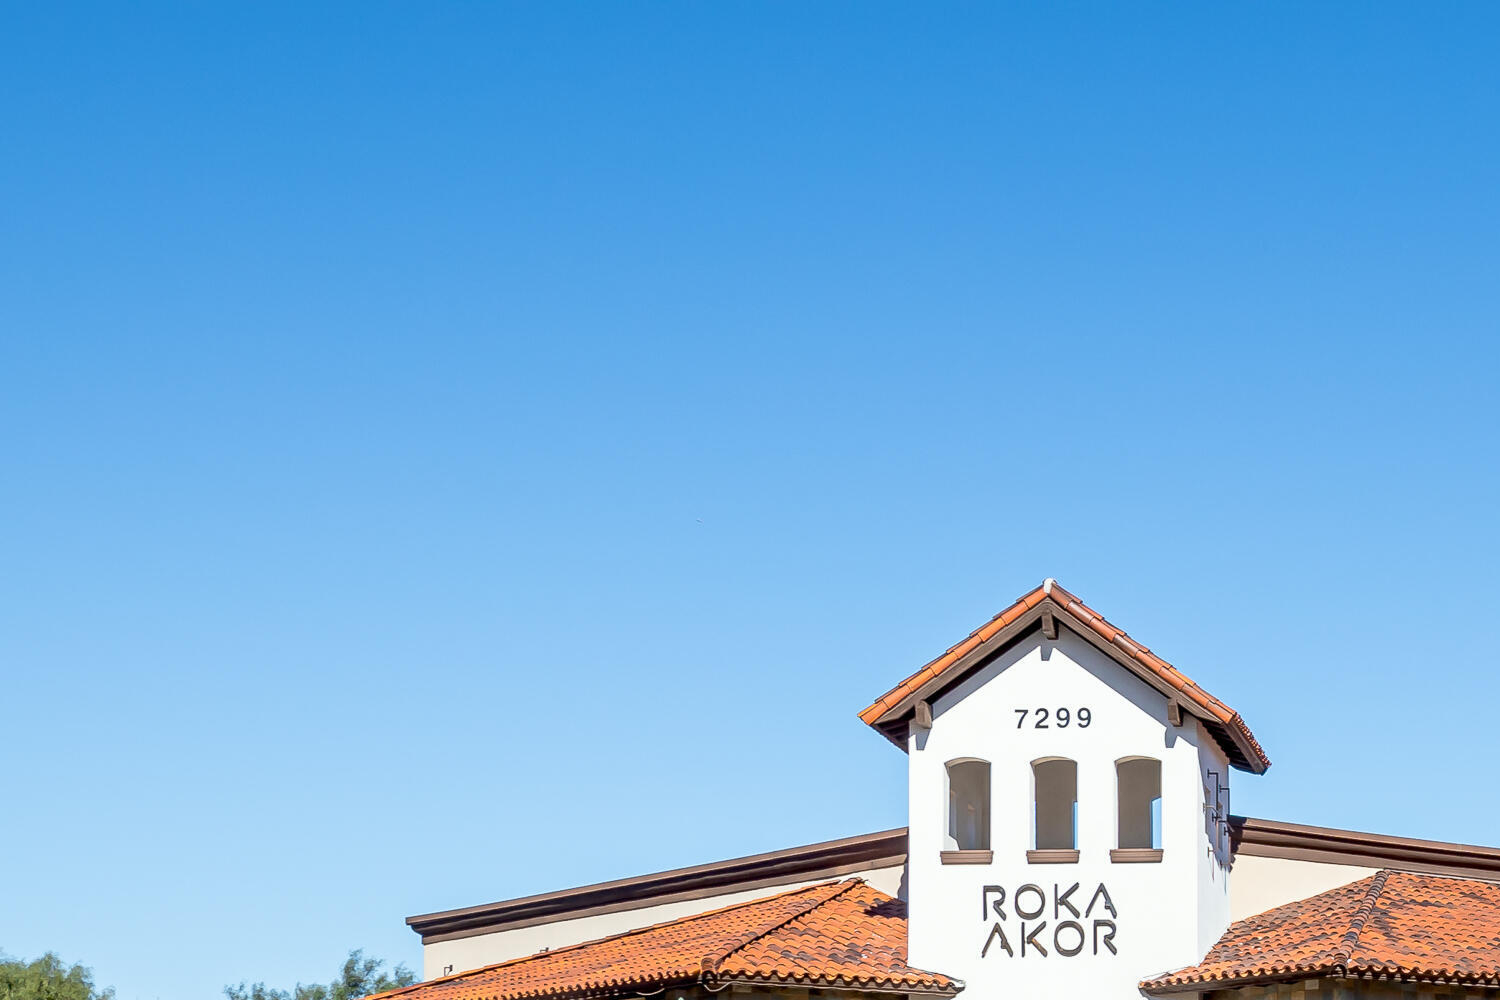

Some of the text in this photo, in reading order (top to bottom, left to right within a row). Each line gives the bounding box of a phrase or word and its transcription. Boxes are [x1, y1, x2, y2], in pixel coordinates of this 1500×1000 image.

[1014, 707, 1092, 729] 7299
[982, 882, 1118, 922] ROKA
[981, 919, 1118, 958] AKOR
